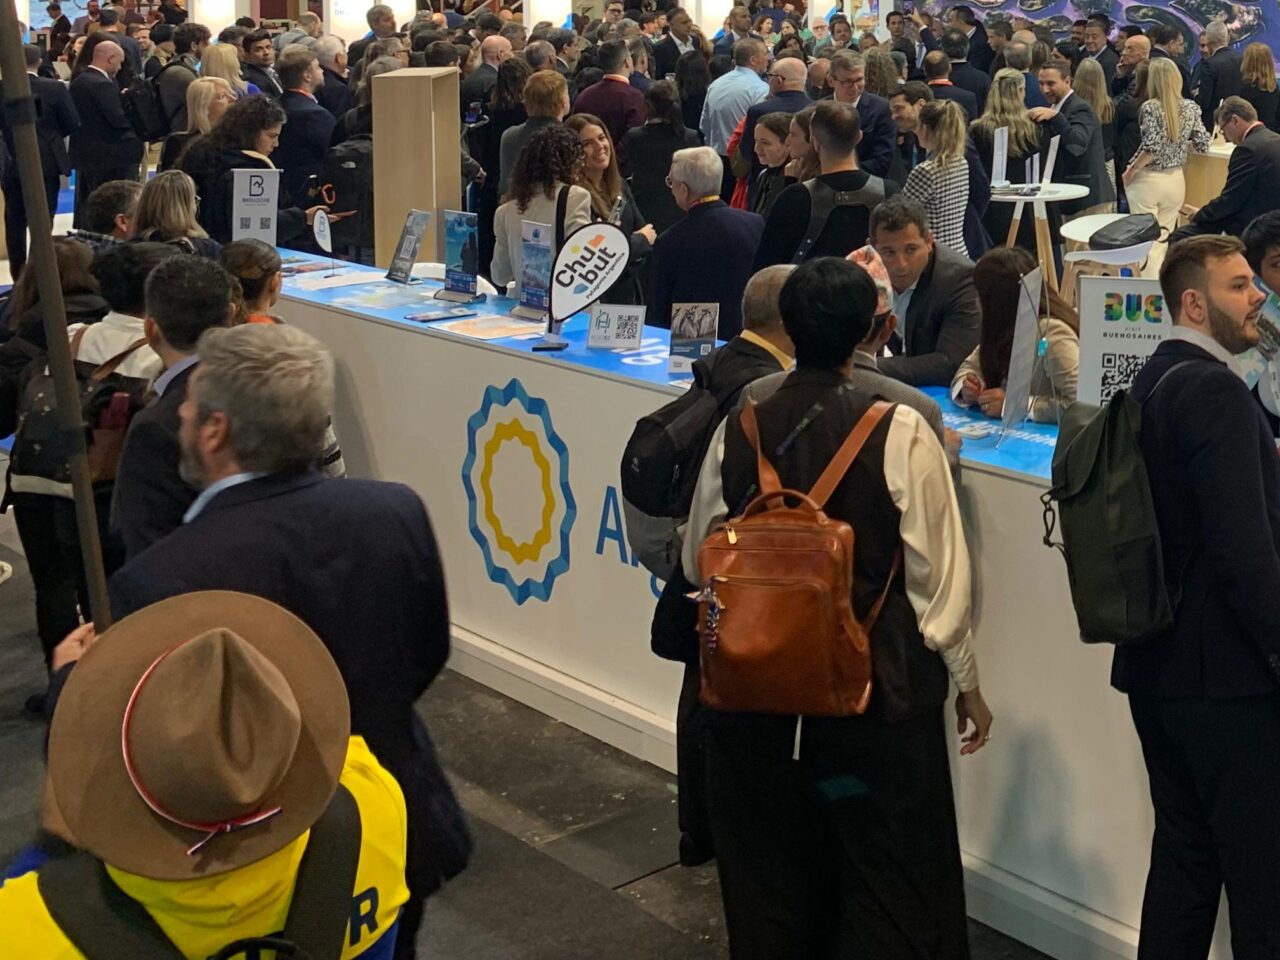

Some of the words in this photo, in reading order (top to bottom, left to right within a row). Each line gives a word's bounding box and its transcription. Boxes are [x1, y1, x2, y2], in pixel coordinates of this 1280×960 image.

[555, 246, 597, 288] Chu
[578, 246, 617, 285] but
[605, 252, 626, 277] Argentina
